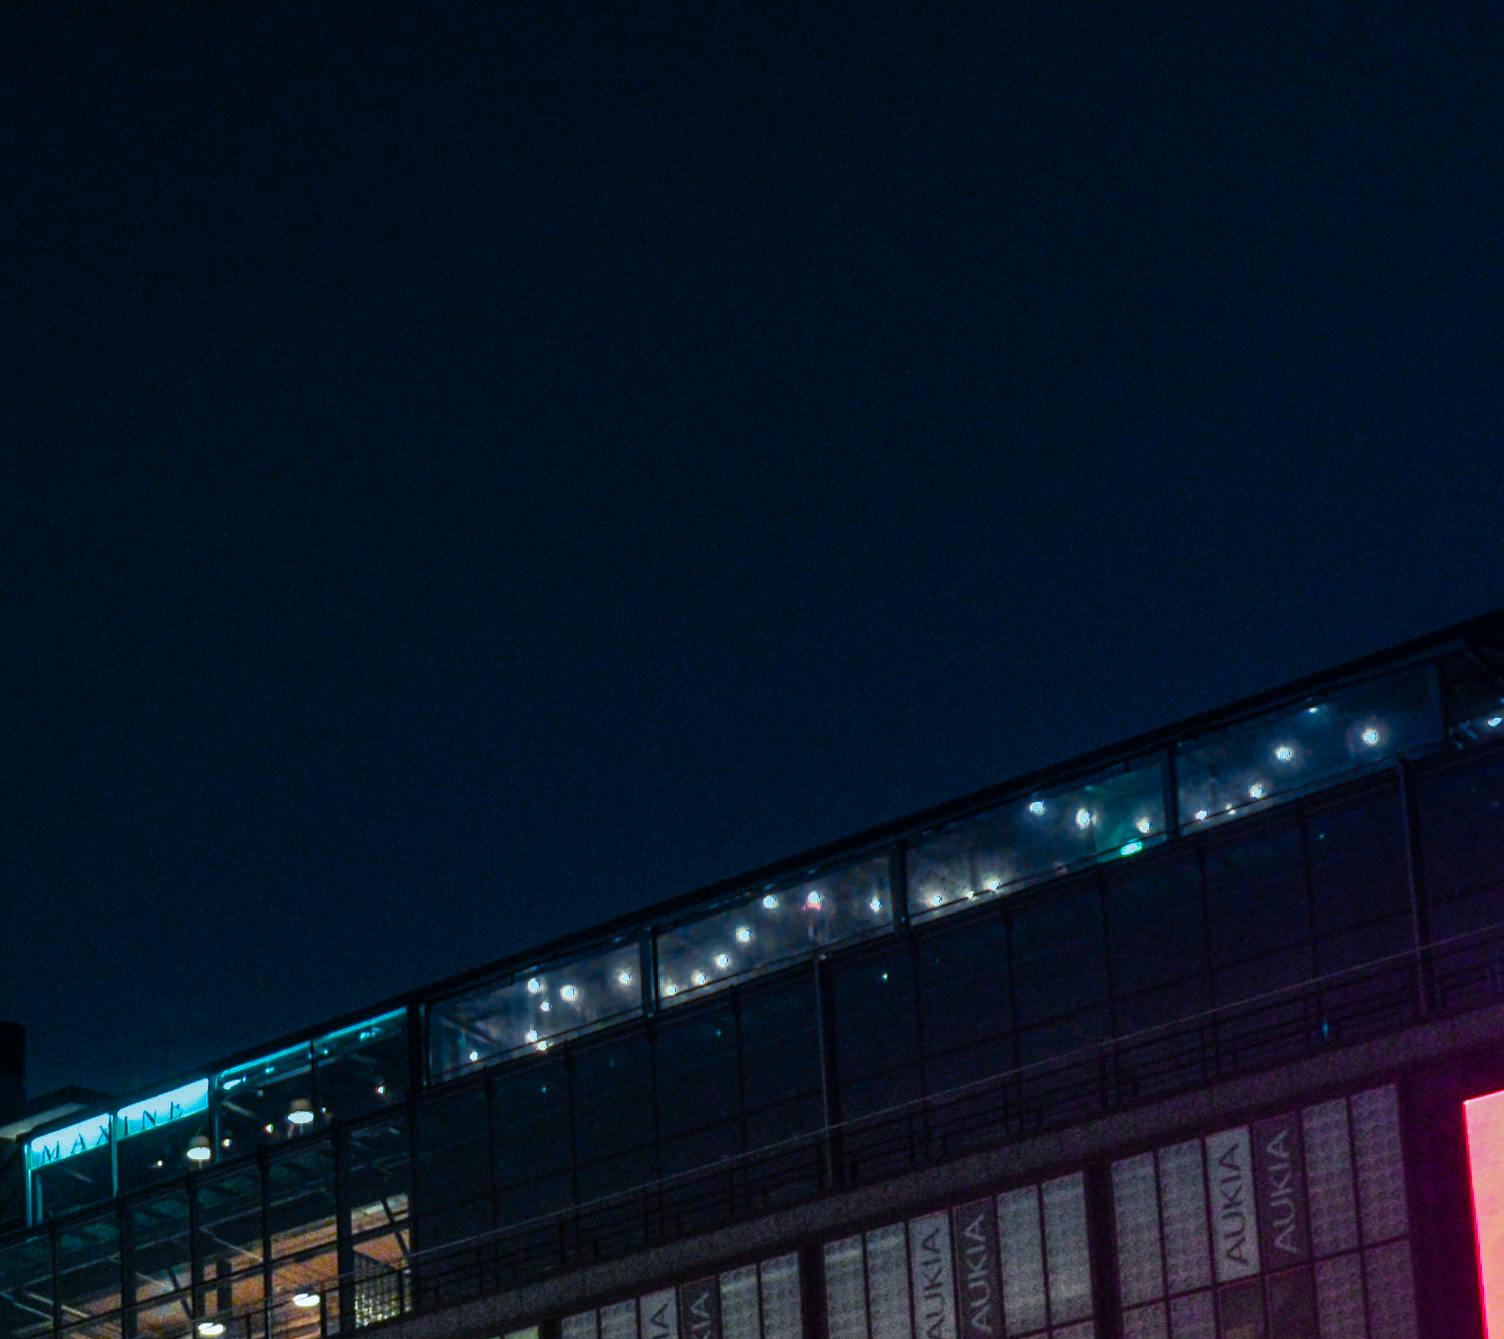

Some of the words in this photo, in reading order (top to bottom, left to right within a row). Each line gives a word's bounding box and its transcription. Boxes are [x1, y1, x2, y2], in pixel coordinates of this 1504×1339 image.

[1219, 1142, 1249, 1266] AUKIA
[1266, 1129, 1299, 1253] AUKIA
[964, 1213, 992, 1334] AUKIA
